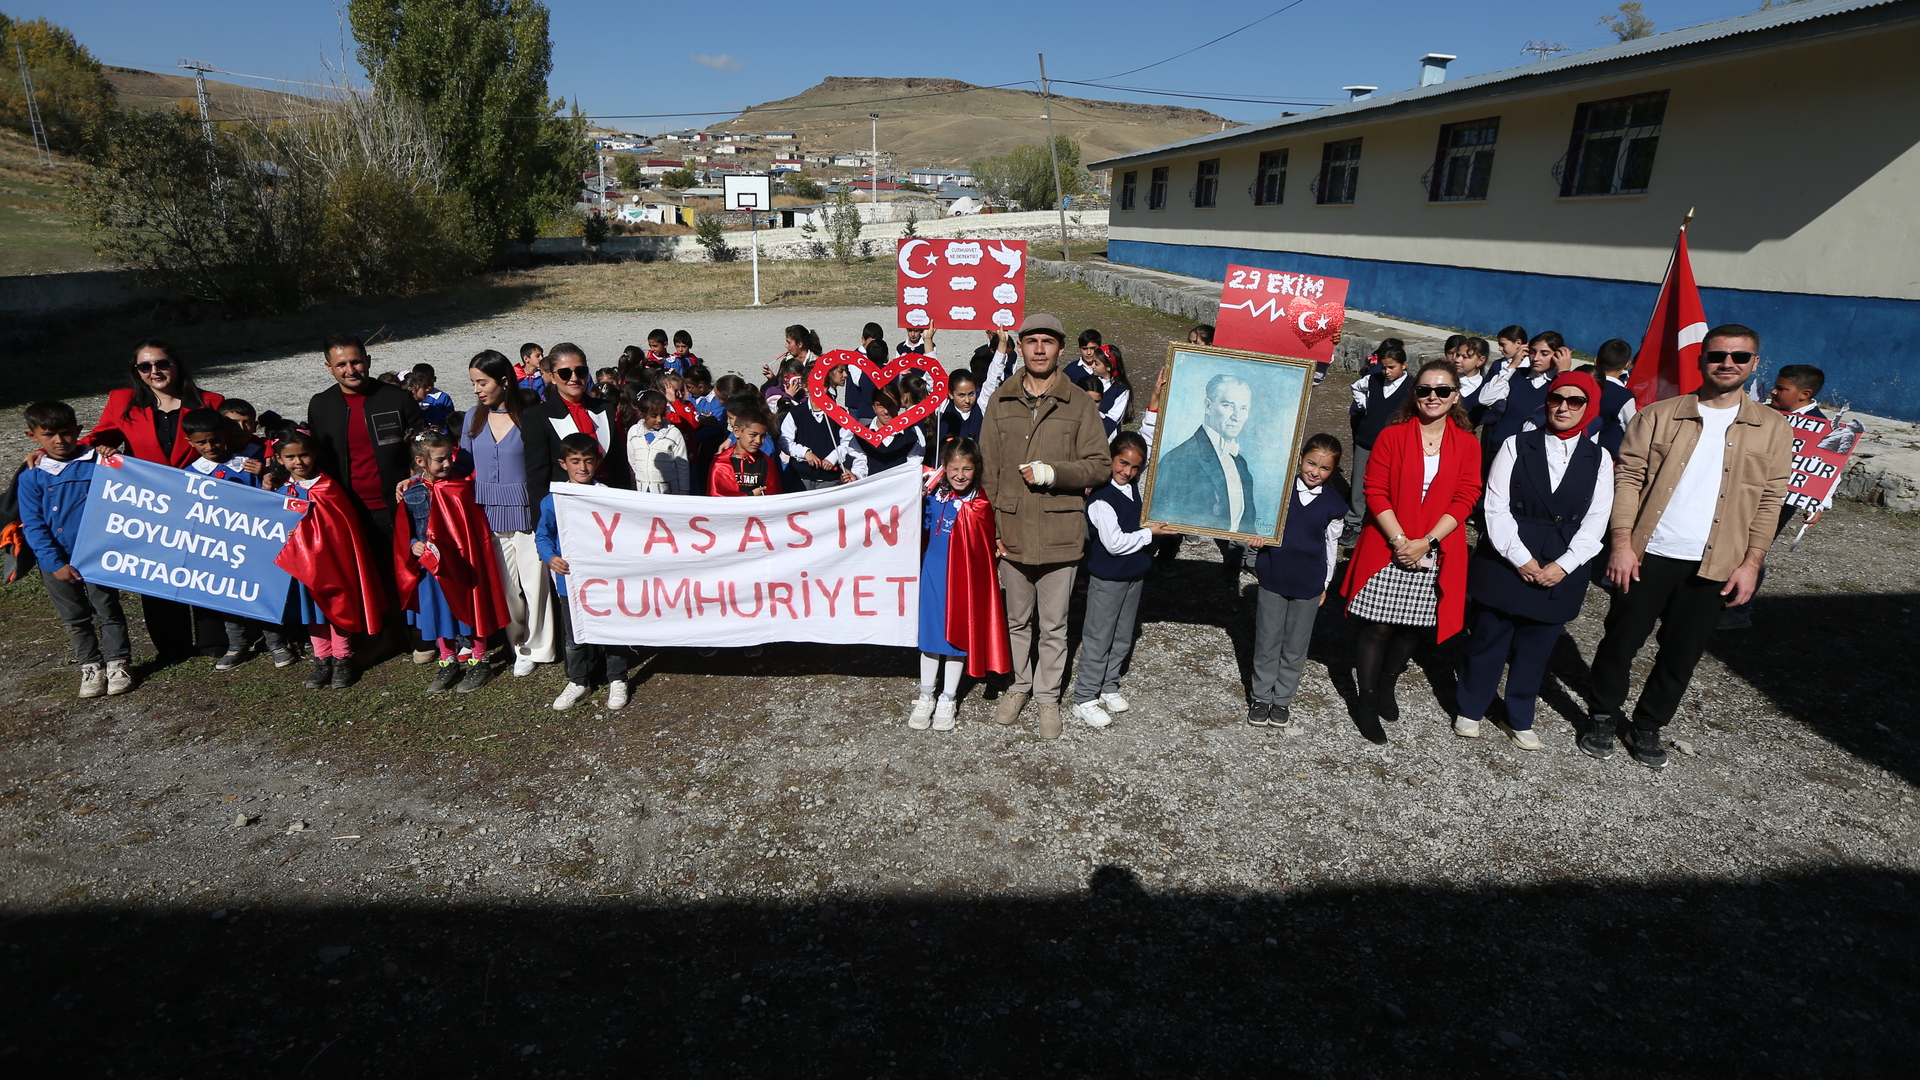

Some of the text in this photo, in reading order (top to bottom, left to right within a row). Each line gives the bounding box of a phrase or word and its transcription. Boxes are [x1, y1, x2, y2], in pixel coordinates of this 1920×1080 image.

[1228, 269, 1325, 299] 29 EKİM
[184, 472, 219, 500] T.C.
[102, 480, 286, 543] KARS AKYAKA
[591, 505, 900, 555] YAŞASIN
[106, 513, 247, 569] BOYUNTAŞ
[102, 551, 260, 602] ORTAOKULU
[579, 572, 918, 619] CUMHURİYET
